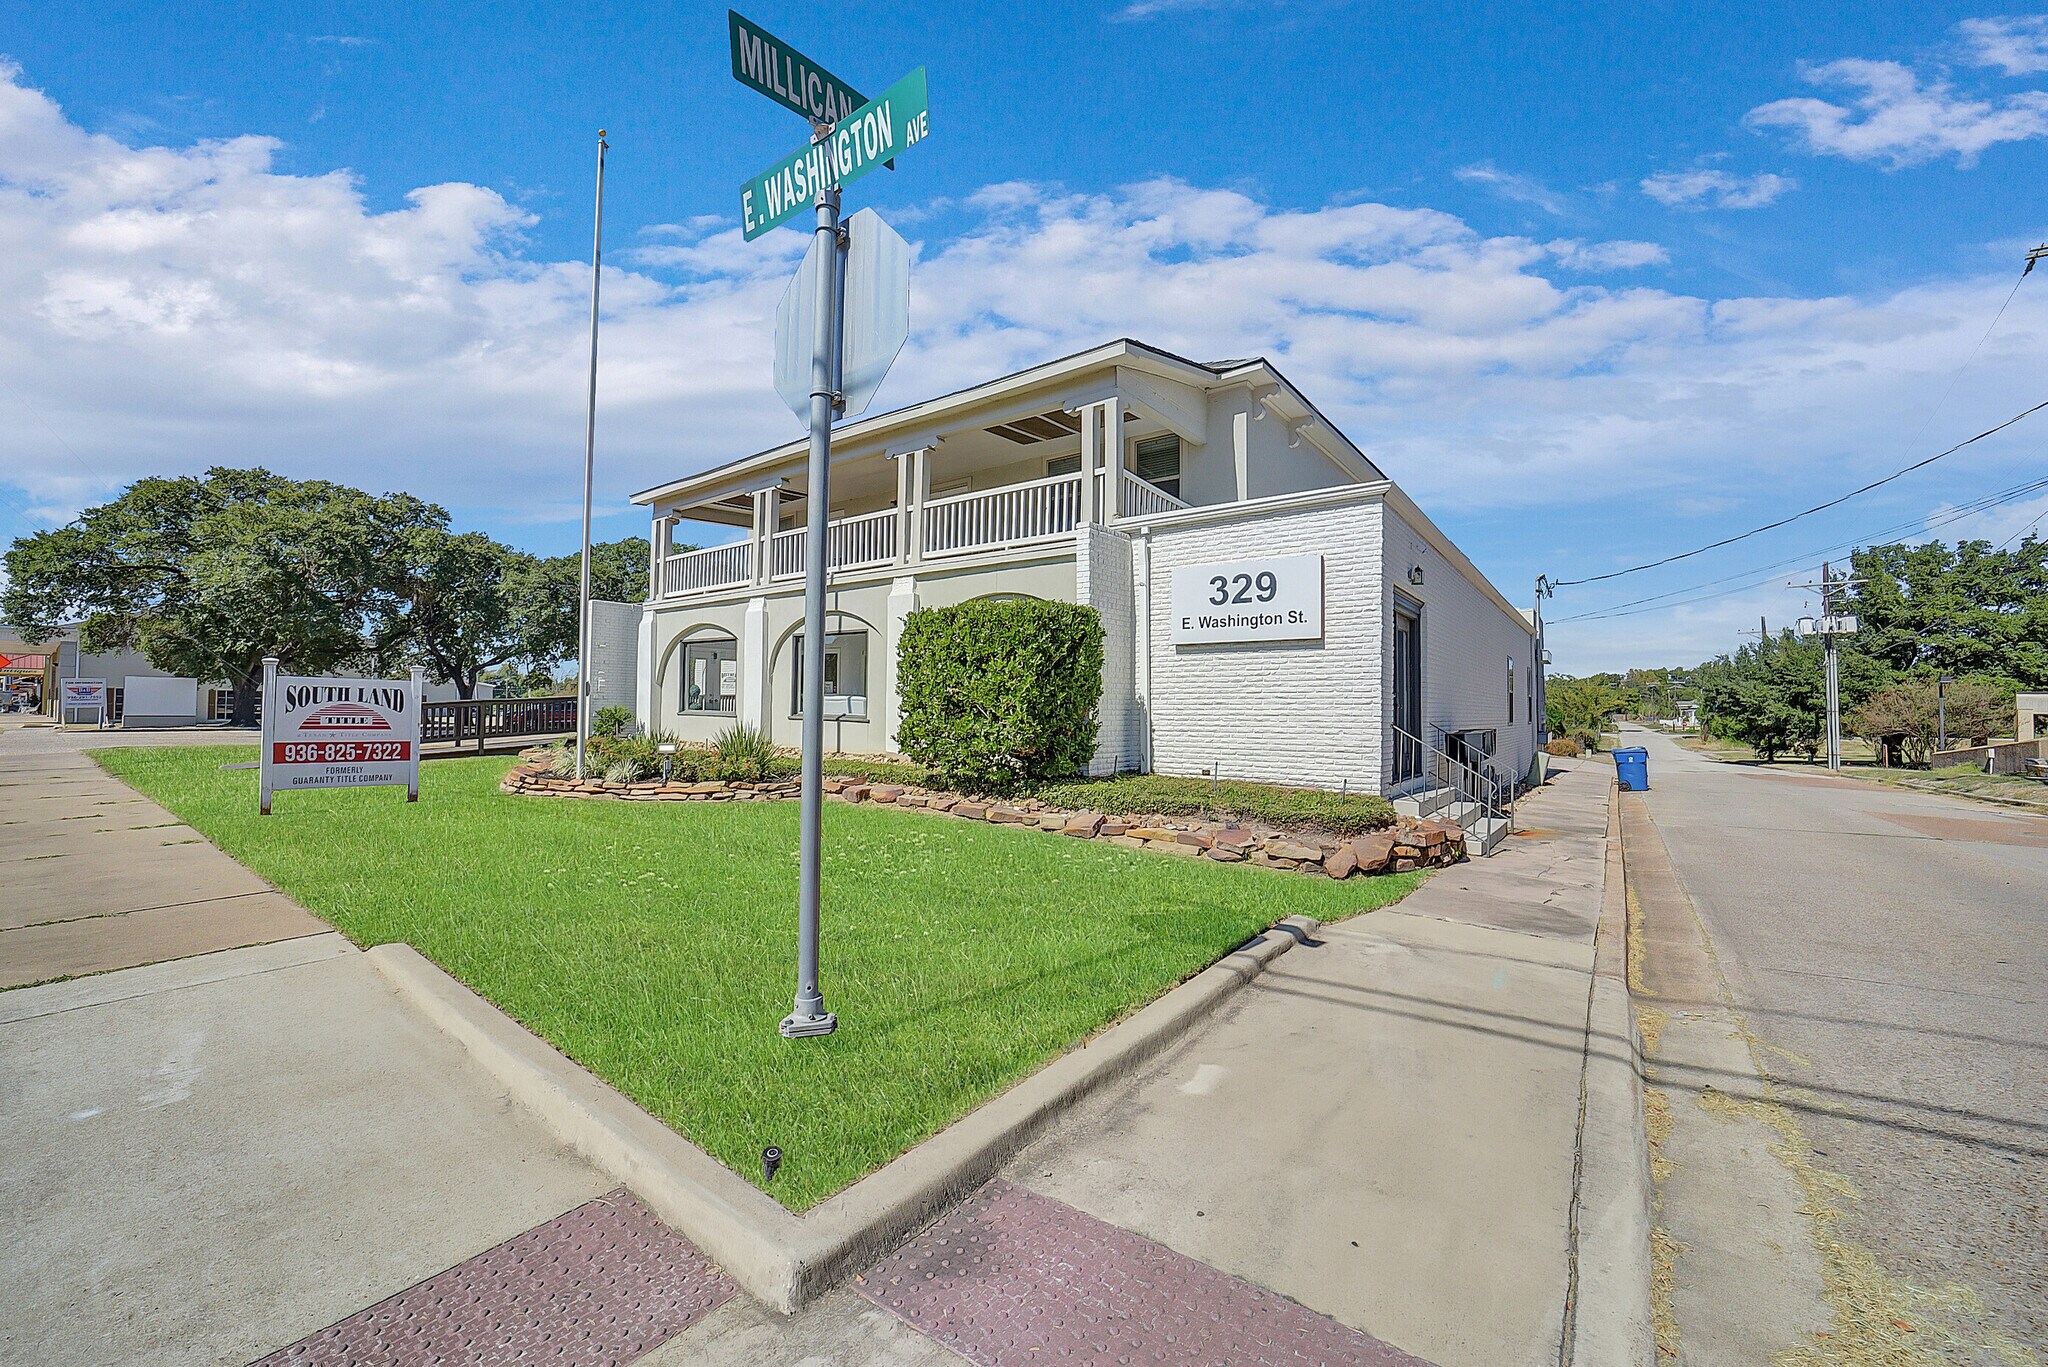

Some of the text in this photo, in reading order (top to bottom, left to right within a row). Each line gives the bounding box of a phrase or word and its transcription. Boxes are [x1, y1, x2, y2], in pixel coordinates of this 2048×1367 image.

[738, 25, 853, 125] MILLICAN
[764, 99, 893, 220] WASHINGTON
[906, 110, 928, 148] AVE
[1208, 571, 1277, 606] 329
[1182, 610, 1308, 630] E. Washington St.
[285, 684, 405, 714] SOUTH LAND
[325, 716, 369, 725] TITLE
[285, 743, 402, 762] 936-825-7322
[292, 774, 393, 785] GUARANTY TITLE COMPANY
[325, 766, 364, 775] FORMERLY
